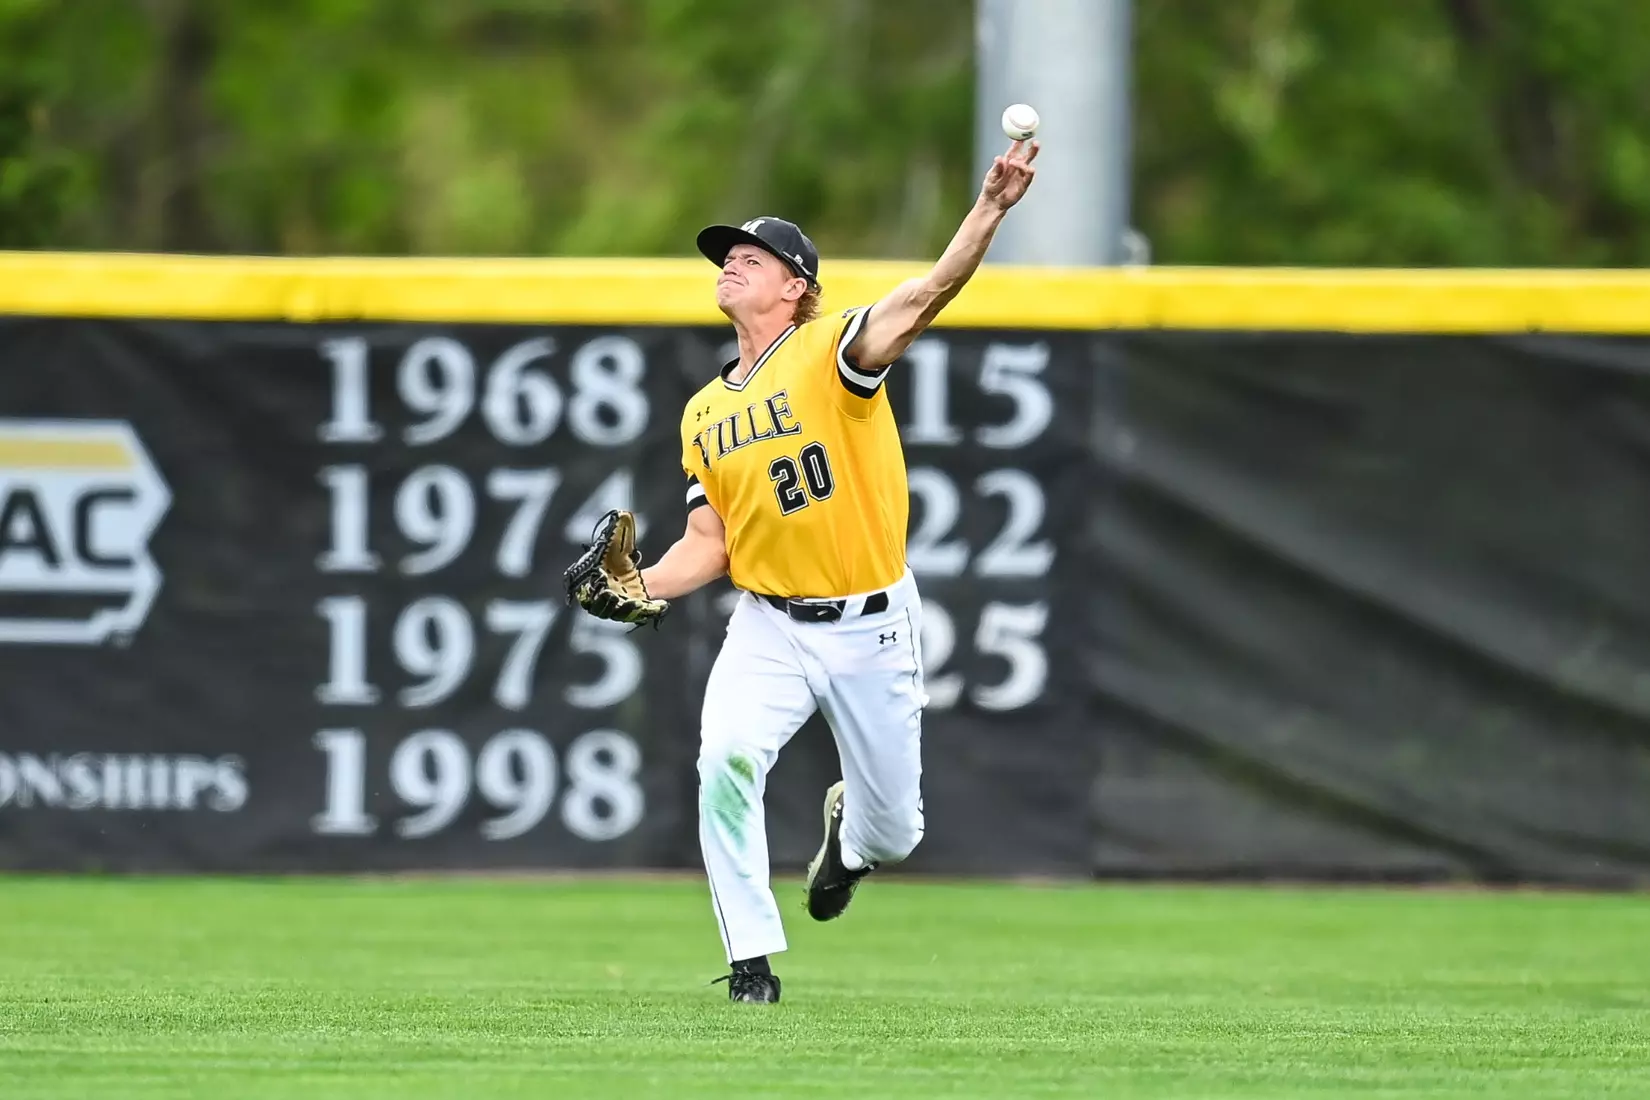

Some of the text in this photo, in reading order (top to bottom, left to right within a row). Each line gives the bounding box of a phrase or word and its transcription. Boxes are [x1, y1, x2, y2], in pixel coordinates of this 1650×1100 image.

[316, 335, 651, 447] 1968
[692, 388, 803, 472] VILLE
[767, 440, 836, 517] 20
[905, 465, 1056, 578] 22
[313, 595, 645, 708] 1975
[311, 727, 646, 840] 1998
